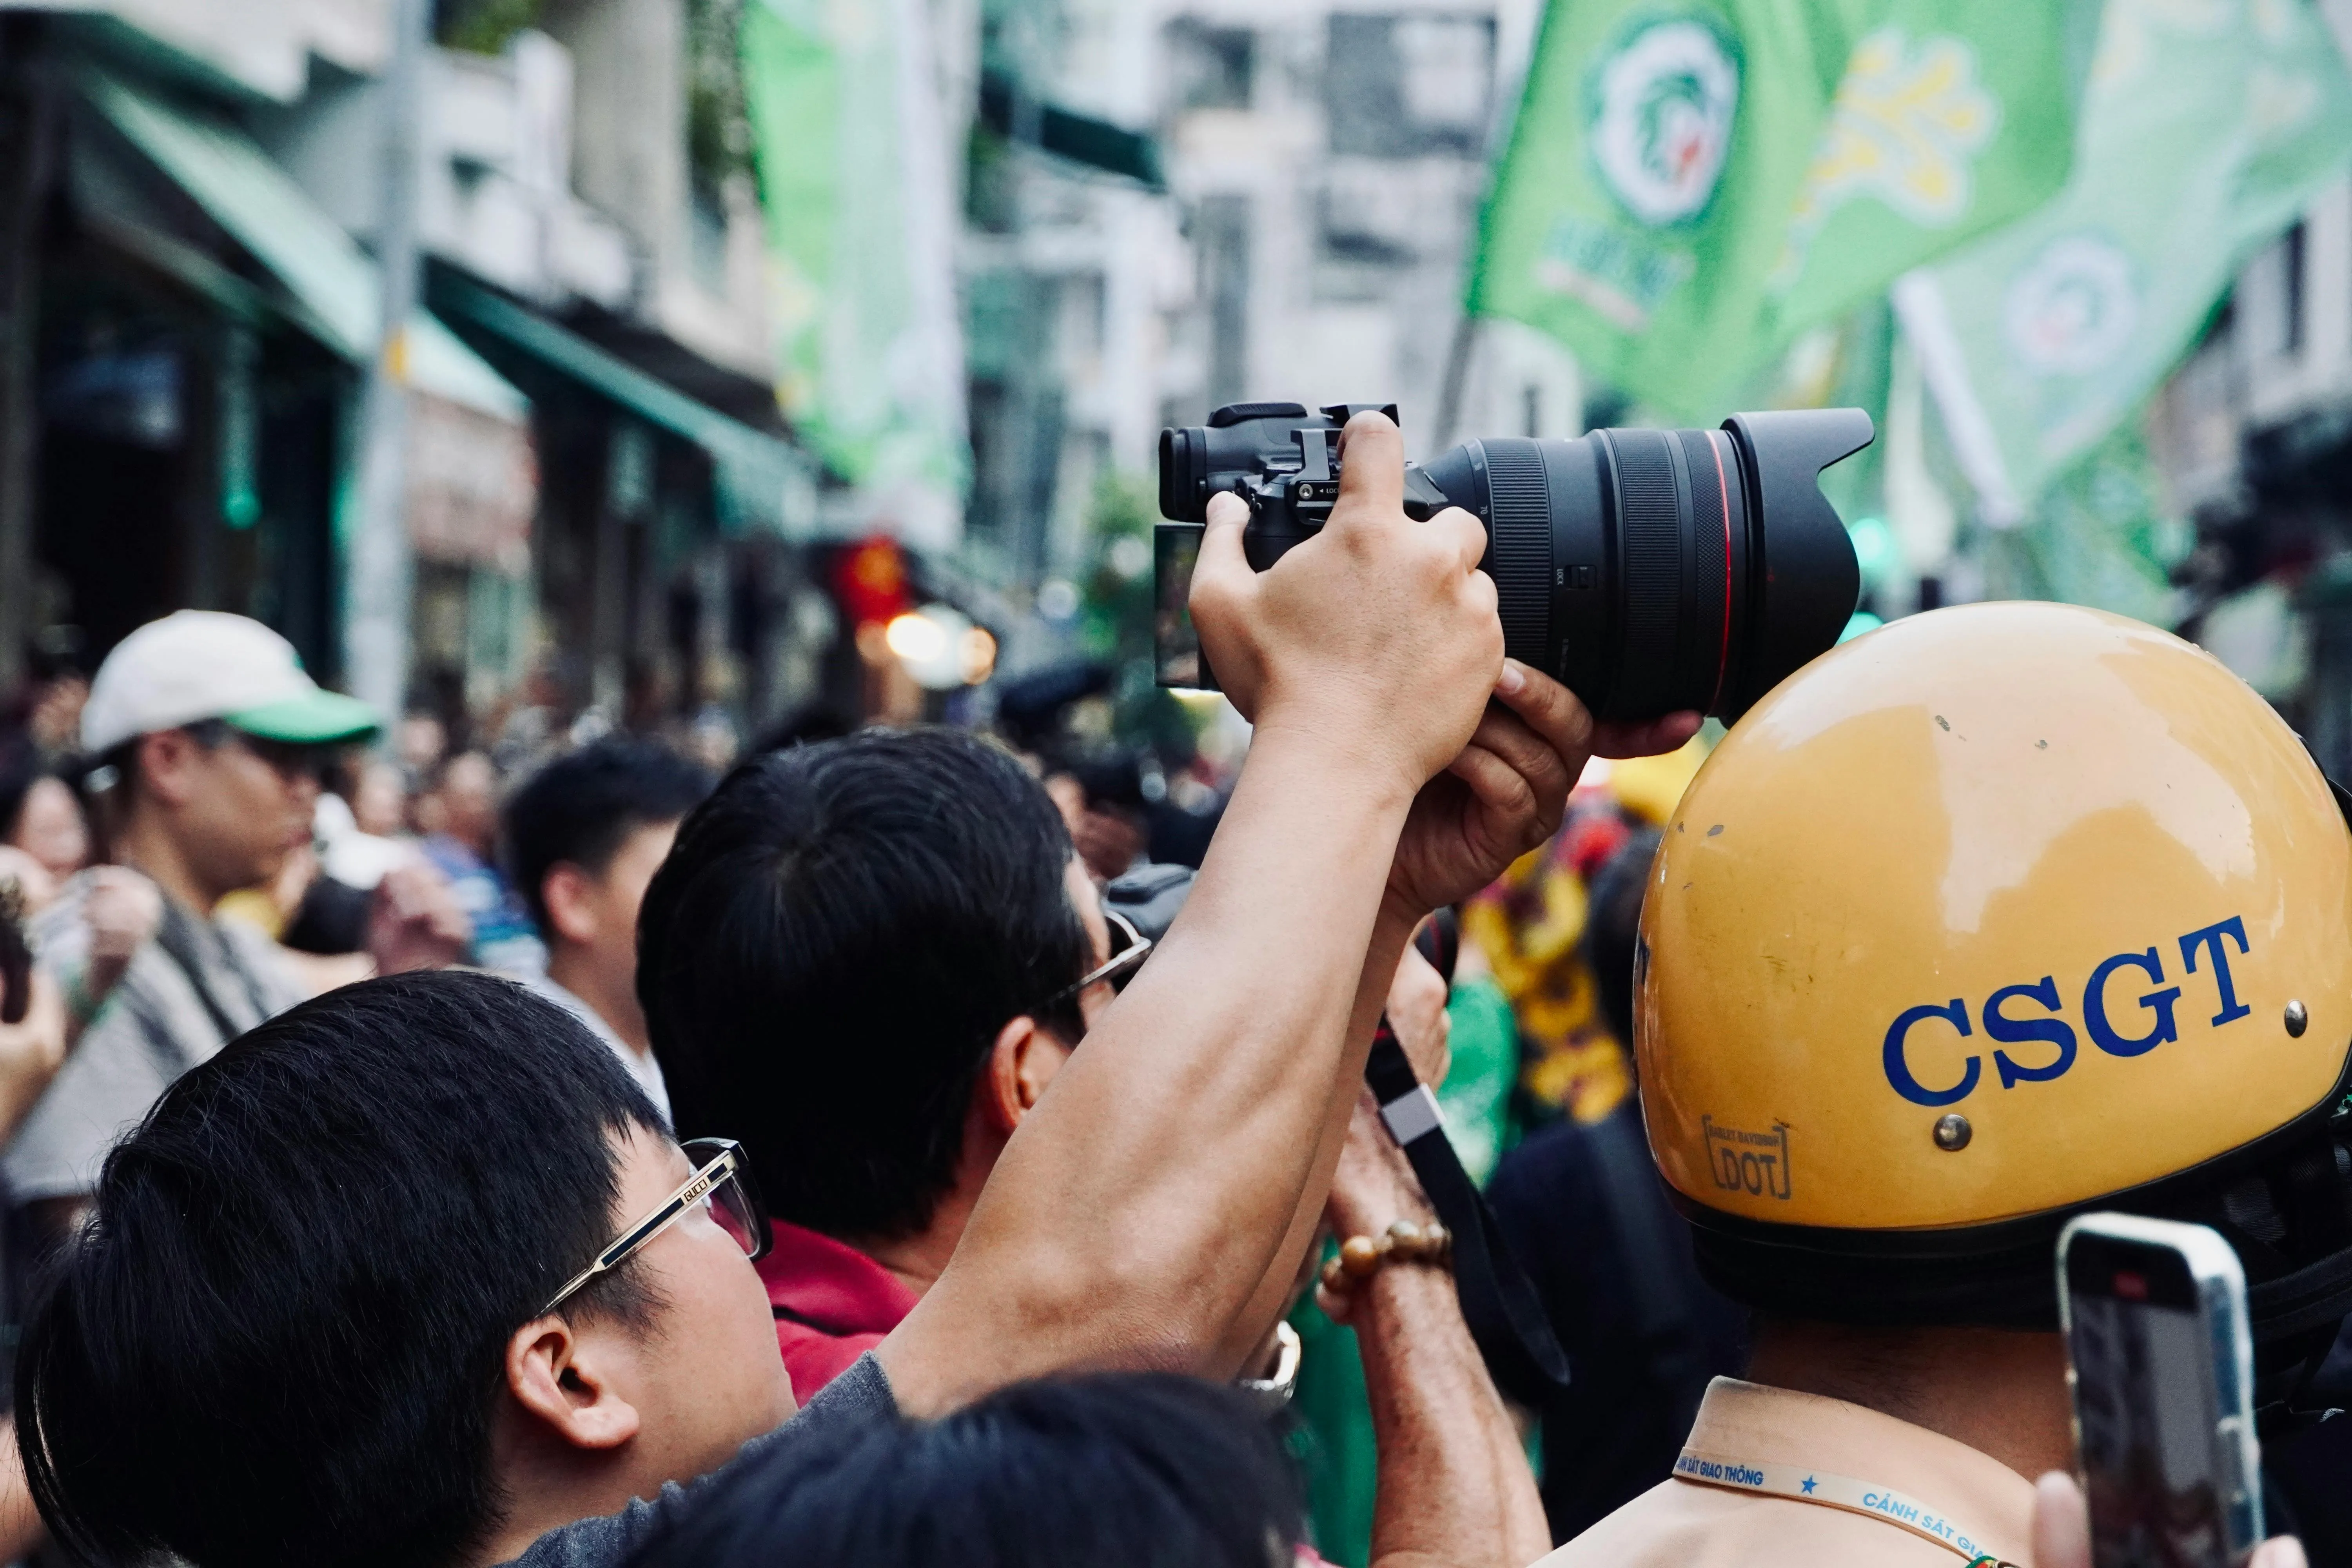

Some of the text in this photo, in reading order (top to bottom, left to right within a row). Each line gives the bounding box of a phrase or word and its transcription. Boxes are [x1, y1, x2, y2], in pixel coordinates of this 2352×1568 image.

[1480, 505, 1488, 515] 70
[1883, 916, 2250, 1106] CSGT
[1722, 1147, 1777, 1196] DOT
[684, 1179, 707, 1202] GUCCI
[1700, 1461, 1722, 1479] GIAO
[1724, 1464, 1764, 1486] THÔNG
[1863, 1493, 1984, 1558] CẢNH SÁT GIA
